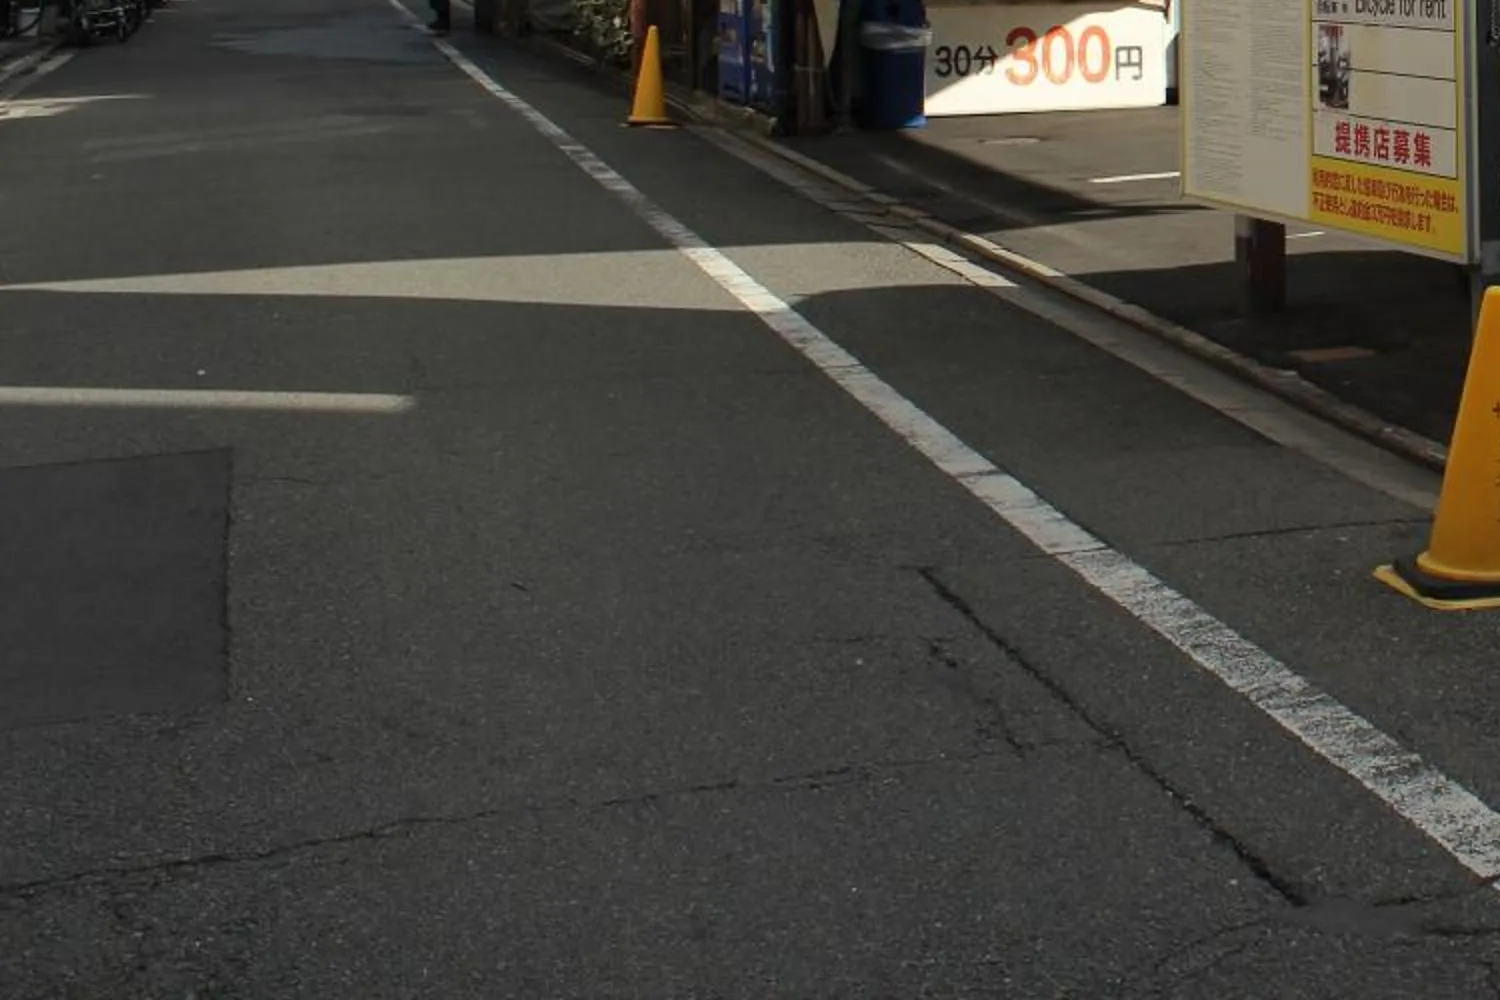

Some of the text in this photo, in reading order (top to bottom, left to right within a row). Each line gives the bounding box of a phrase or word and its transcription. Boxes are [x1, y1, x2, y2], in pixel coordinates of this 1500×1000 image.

[1334, 120, 1432, 168] 提携店募集
